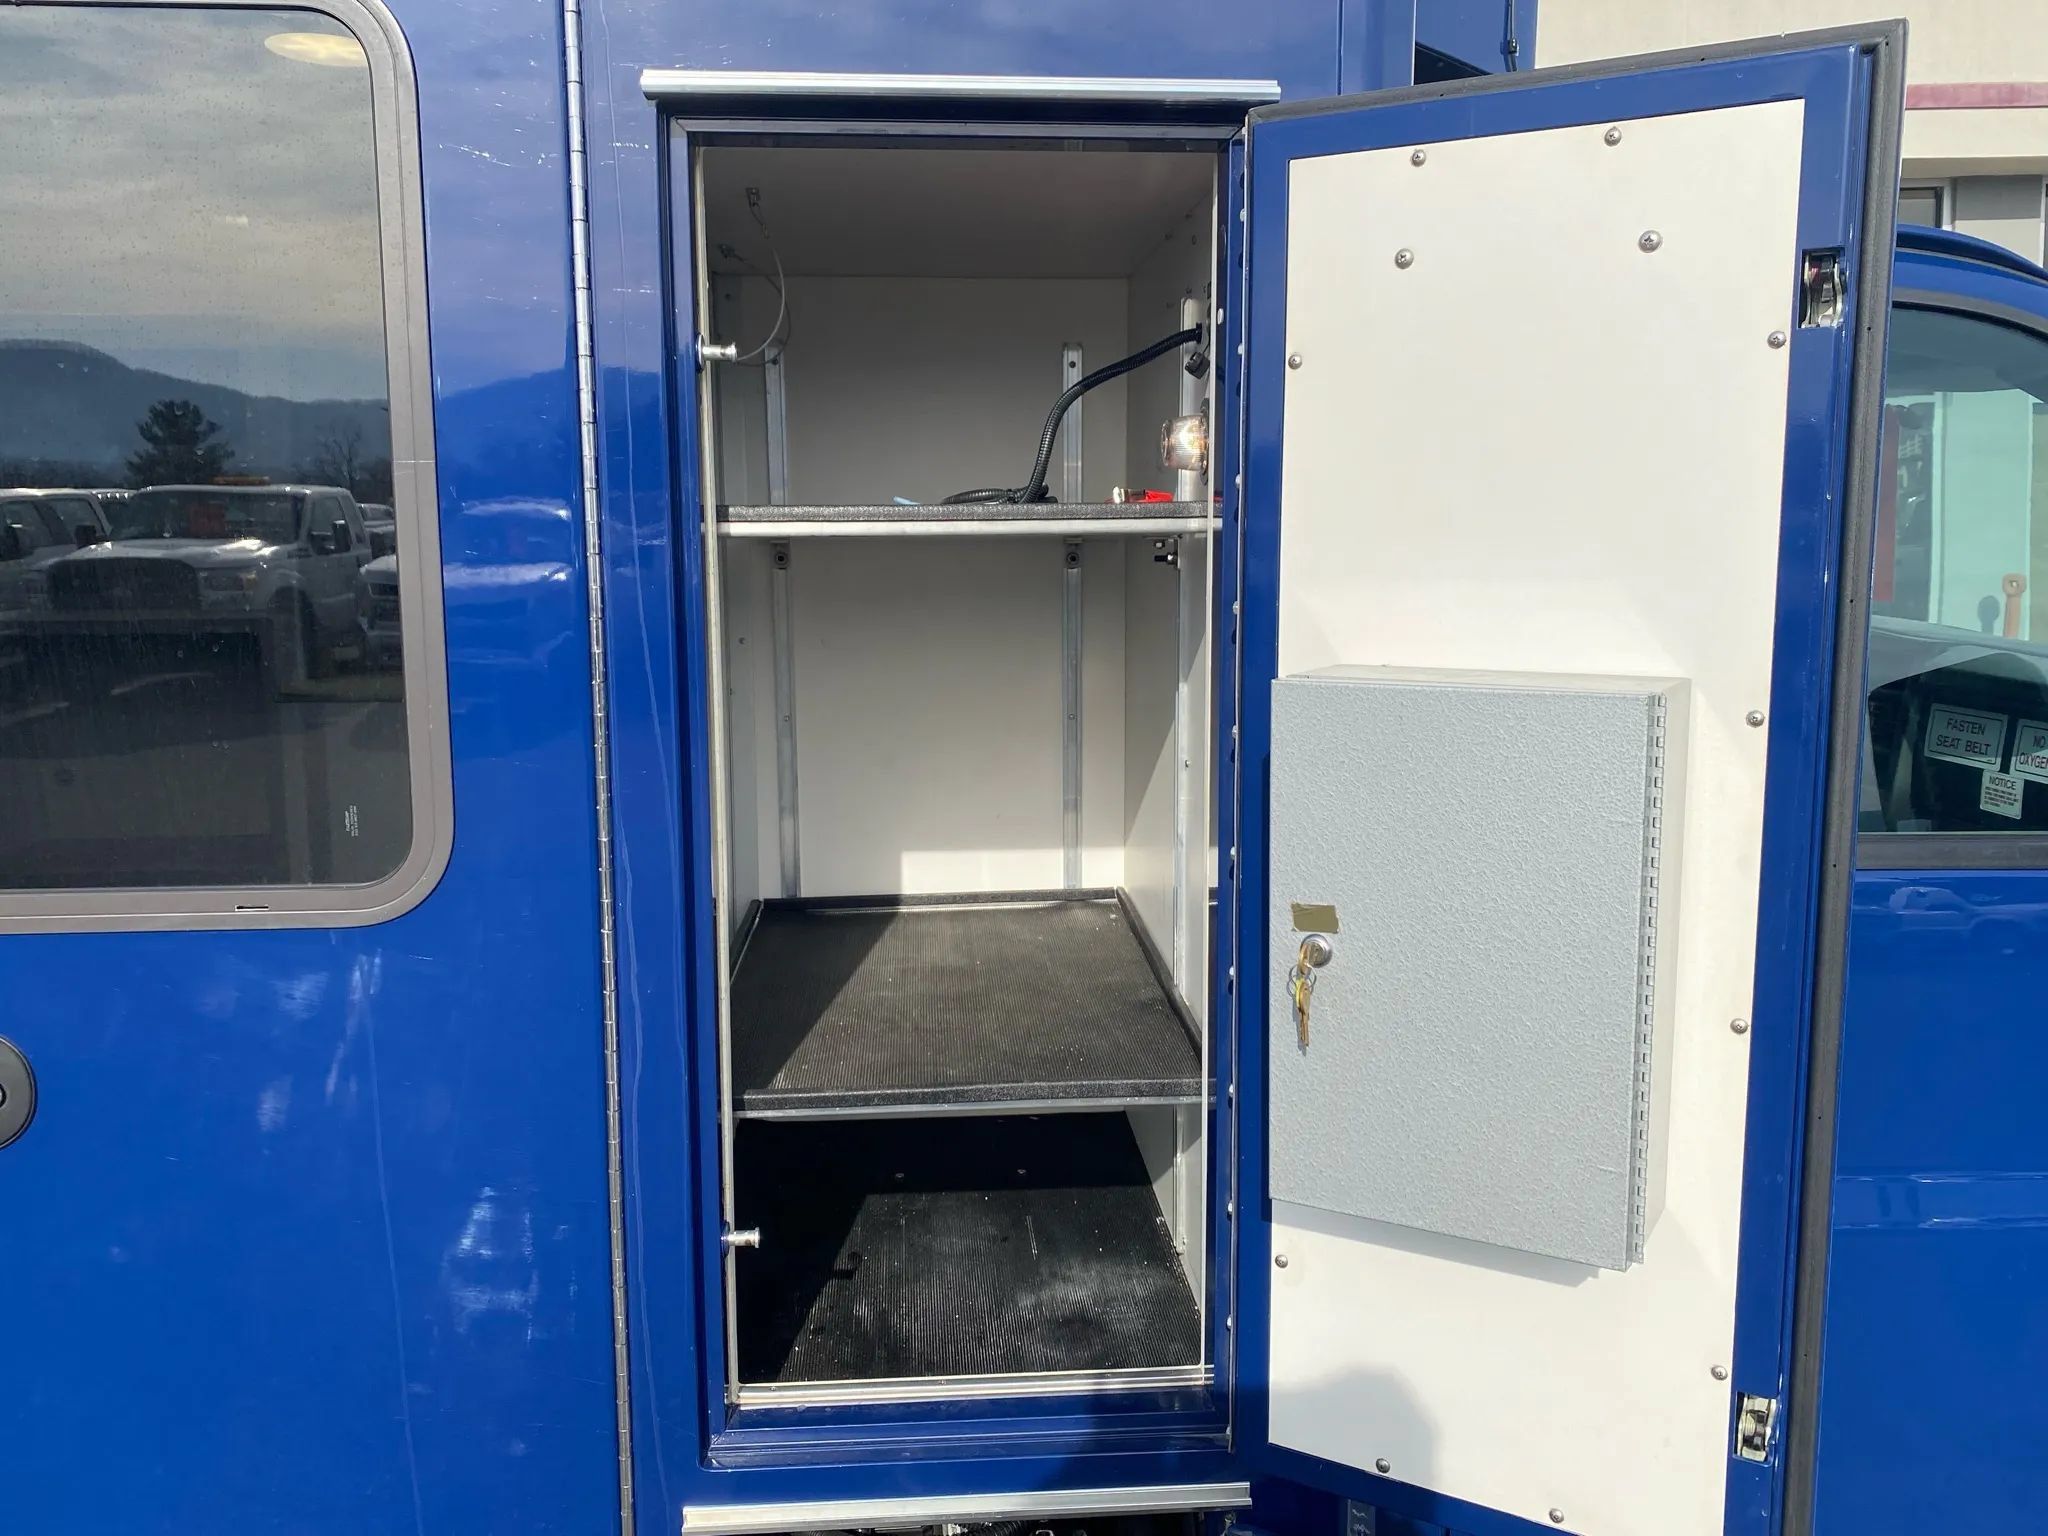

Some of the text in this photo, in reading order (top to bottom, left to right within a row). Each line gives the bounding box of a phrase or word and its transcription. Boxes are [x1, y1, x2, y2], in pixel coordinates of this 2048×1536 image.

[1947, 718, 1985, 736] FASTEN
[1936, 734, 1992, 756] SEAT BELT
[2032, 735, 2046, 748] NO
[1989, 775, 2016, 790] NOTICE
